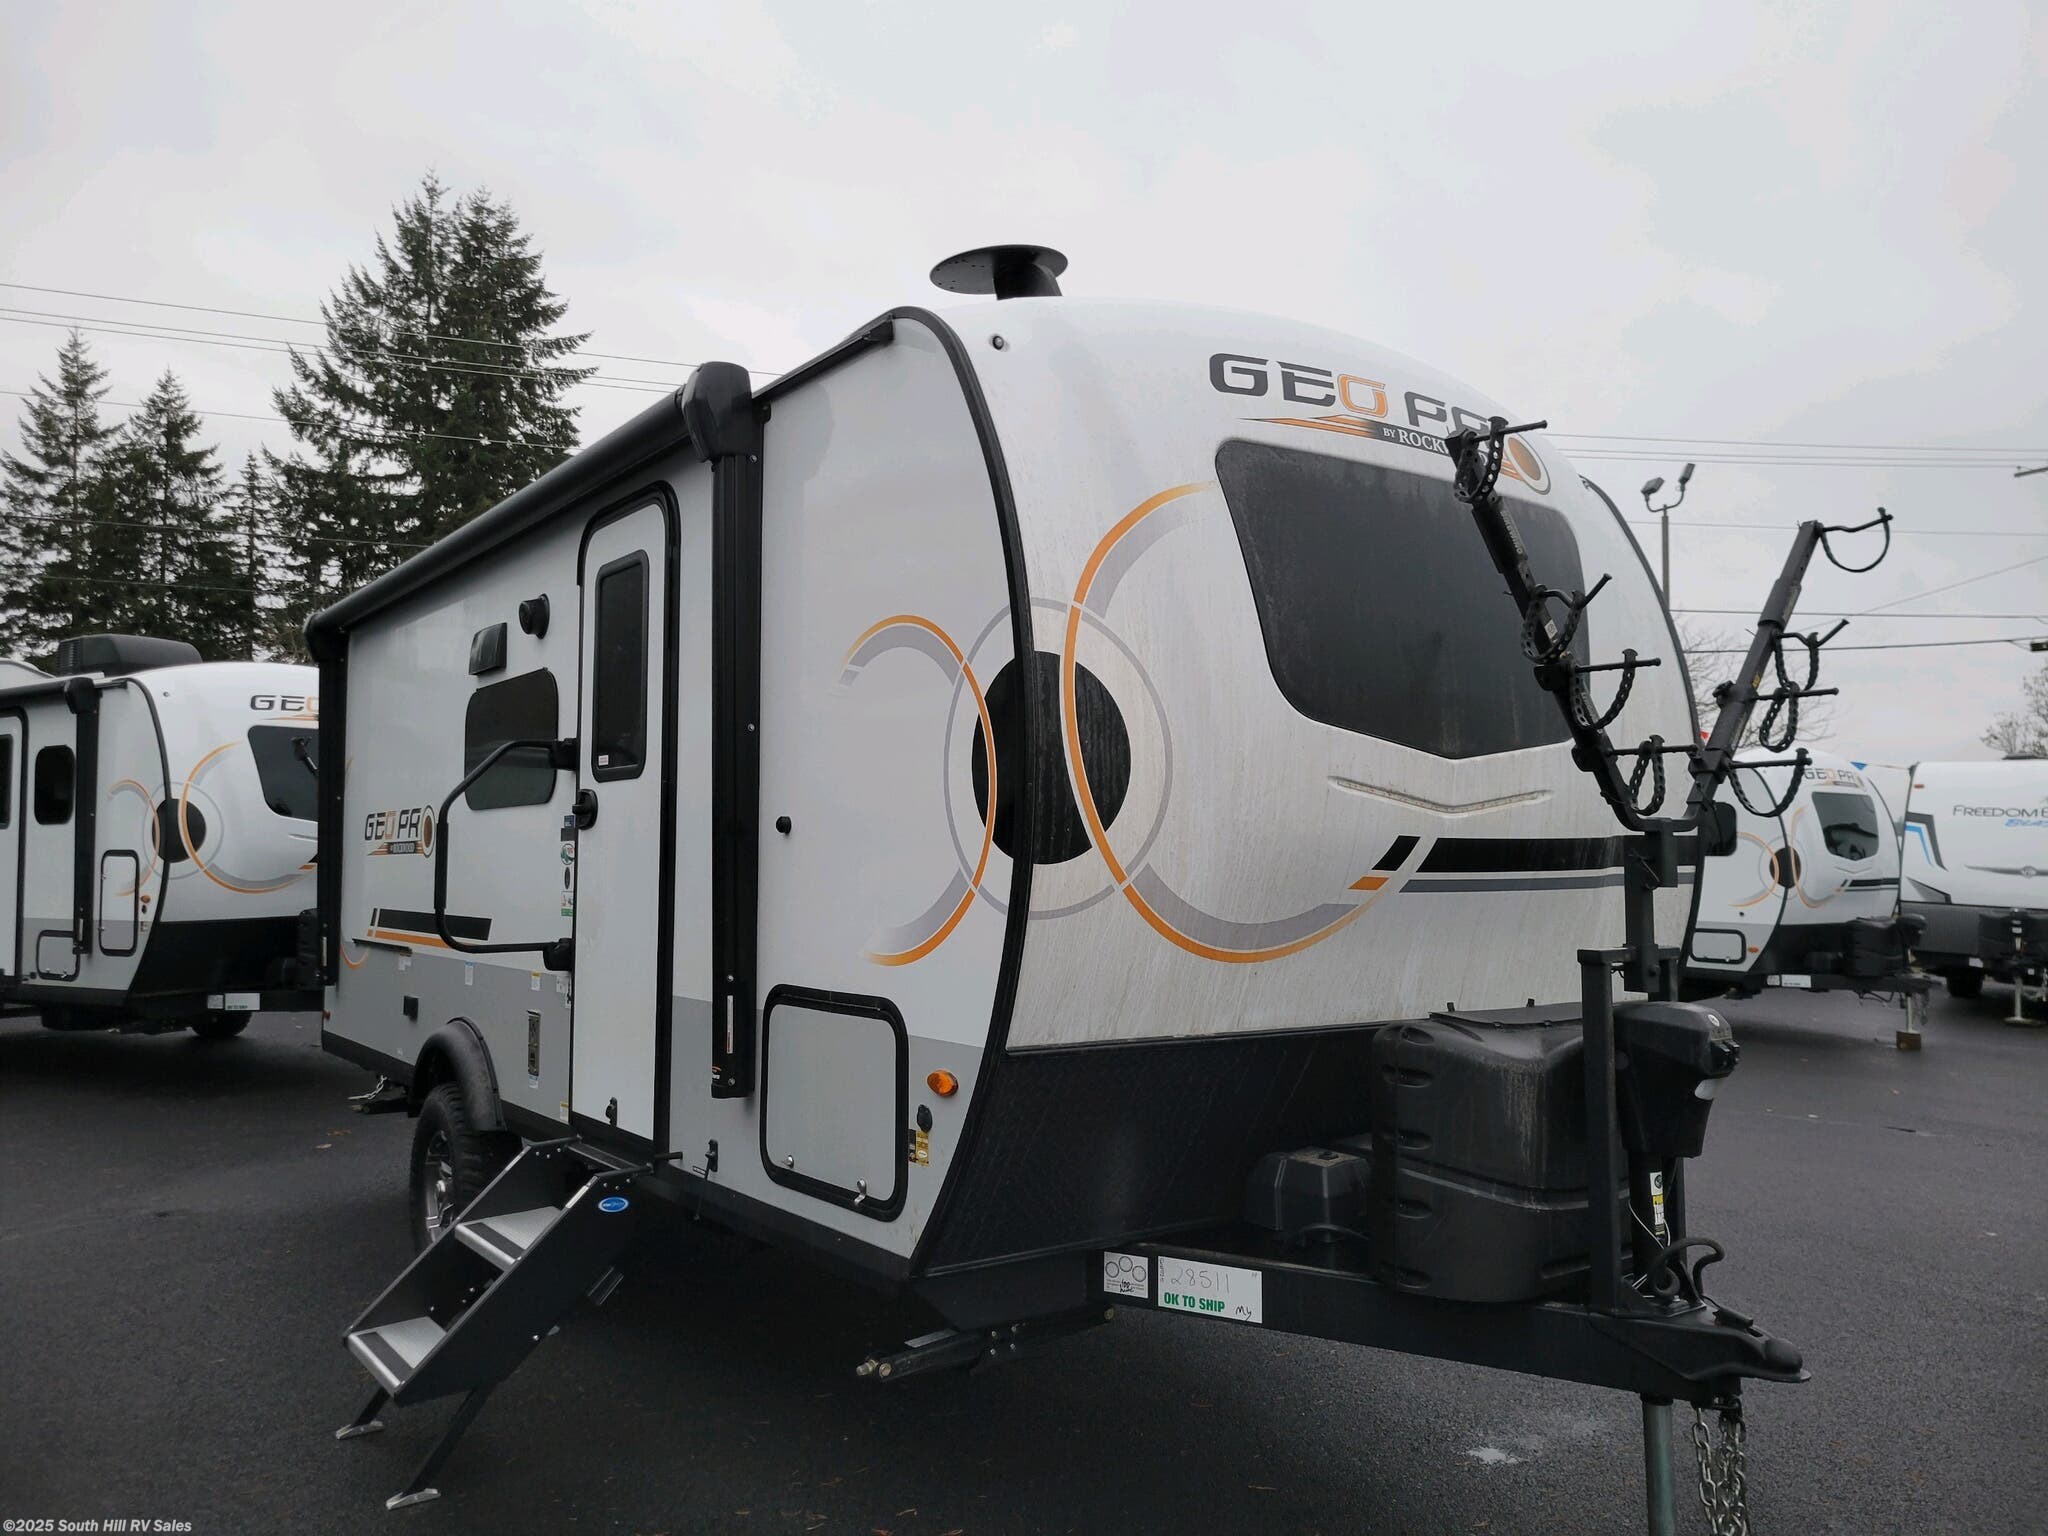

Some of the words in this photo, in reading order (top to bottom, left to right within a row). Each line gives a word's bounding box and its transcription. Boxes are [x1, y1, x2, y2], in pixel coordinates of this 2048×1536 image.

[1209, 353, 1388, 418] GEO
[1383, 427, 1396, 438] BY
[1952, 804, 2038, 818] FREEDOM
[364, 810, 397, 841] GEO
[1164, 1292, 1179, 1306] OK
[1182, 1295, 1196, 1308] TO
[1199, 1298, 1226, 1313] SHIP
